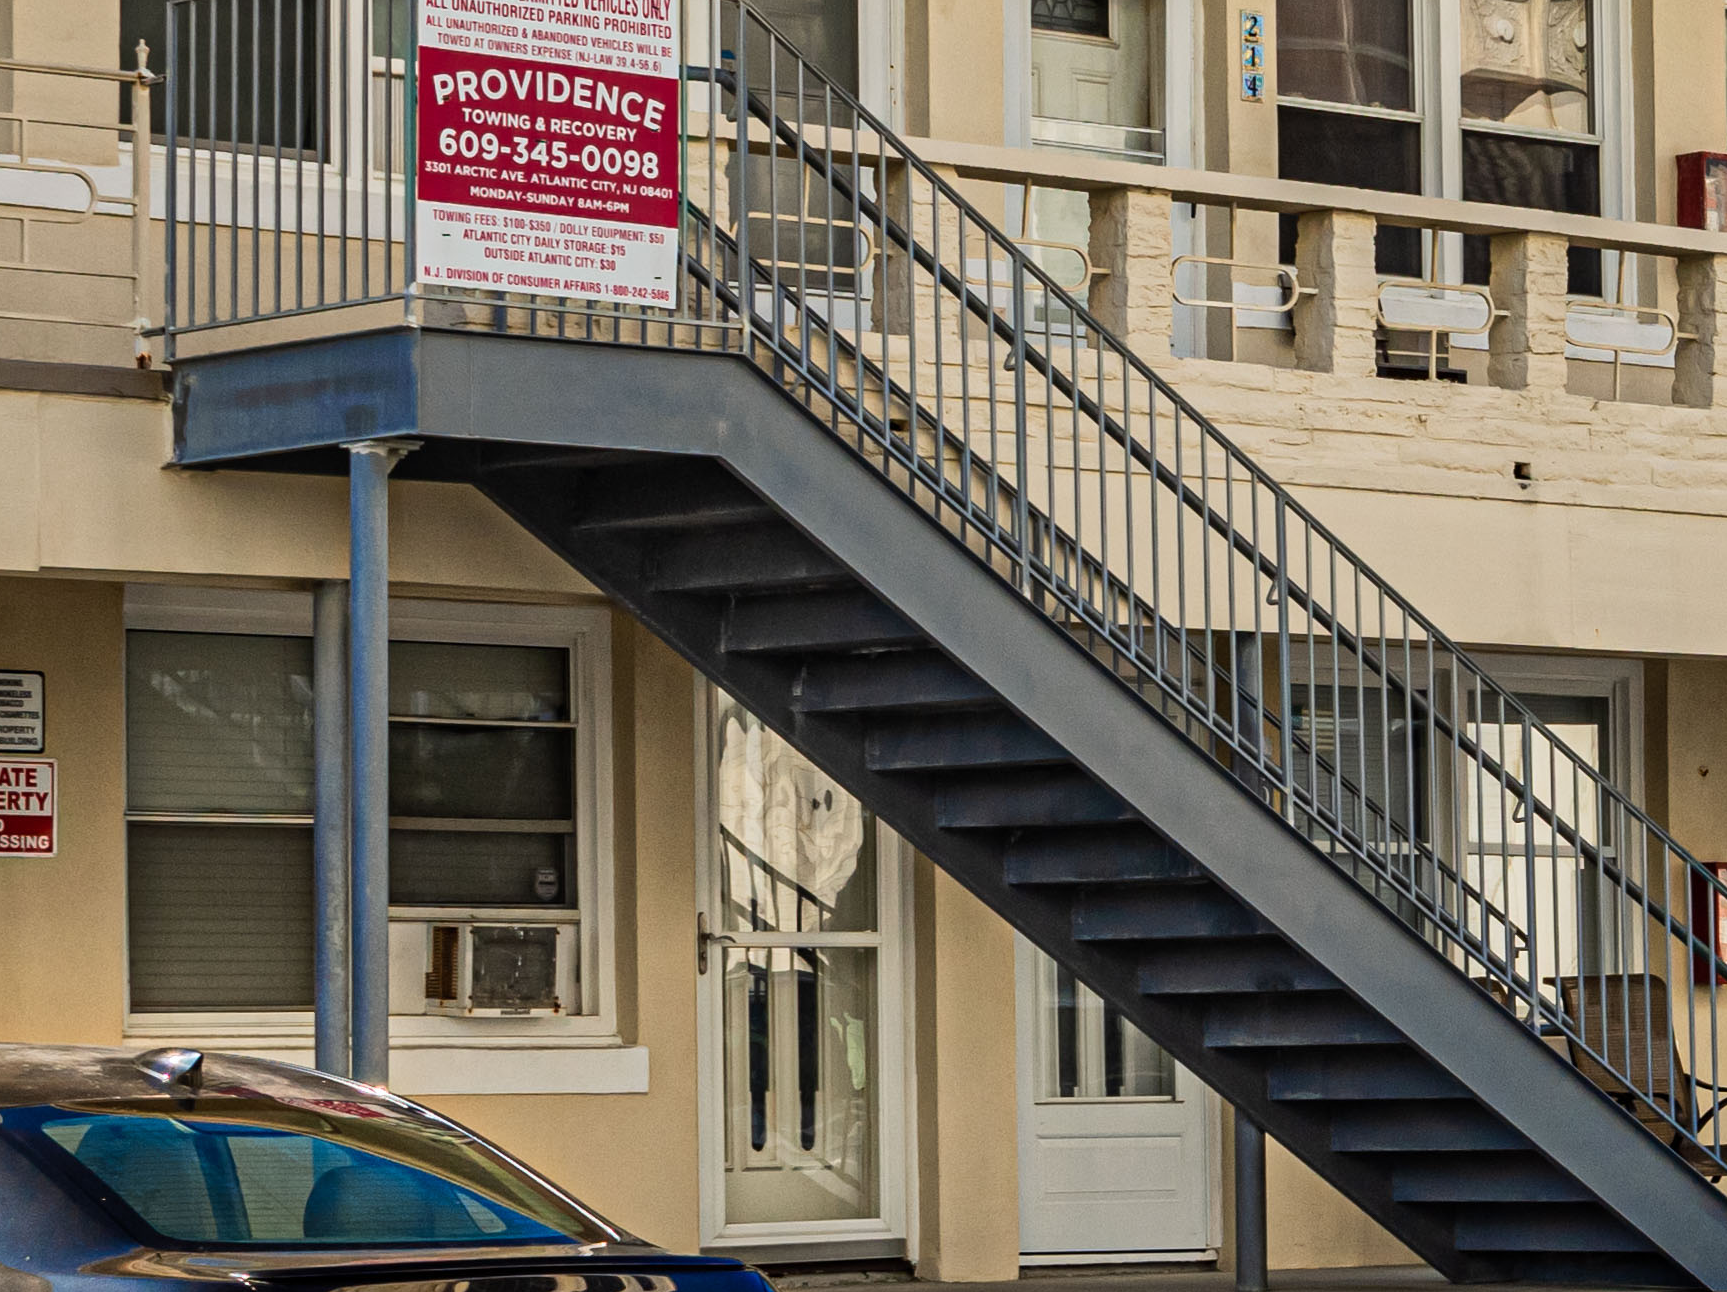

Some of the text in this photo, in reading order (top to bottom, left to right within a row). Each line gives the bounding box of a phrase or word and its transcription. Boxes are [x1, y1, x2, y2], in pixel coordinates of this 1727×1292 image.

[426, 15, 672, 58] ALL UNAUTHORIZED & ABANDONED VEHICLES WILL BE
[548, 10, 600, 29] PARKING
[604, 17, 672, 39] PROHIBITED
[437, 32, 471, 47] TOWED
[474, 38, 484, 49] AT
[488, 40, 528, 54] OWNERS
[531, 45, 572, 60] EXPENSE
[433, 69, 666, 132] PROVIDENCE
[461, 107, 637, 142] TOWING & RECOVERY
[439, 128, 659, 179] 609-345-0098
[424, 160, 451, 173] 3301
[454, 165, 498, 178] ARCTIC
[530, 173, 588, 189] ATLANTIC
[591, 180, 620, 195] CITY,
[623, 184, 637, 195] NJ
[639, 186, 673, 199] 08401
[470, 186, 629, 213] MONDAY-SUNDAY 8AM-6PM
[433, 209, 471, 224] TOWING
[474, 214, 500, 226] FEES:
[560, 223, 589, 236] DOLLY
[592, 227, 646, 242] EQUIPMENT:
[649, 233, 665, 245] $50
[463, 229, 626, 256] ATLANTIC CITY DAILY STORAGE: $15
[484, 247, 525, 261] OUTSIDE
[528, 252, 572, 267] ATLANTIC
[574, 256, 598, 269] CITY:
[424, 266, 443, 278] N.J.
[447, 268, 489, 283] DIVISION
[492, 273, 504, 284] OF
[507, 274, 561, 289] CONSUMER
[563, 279, 602, 294] AFFAIRS
